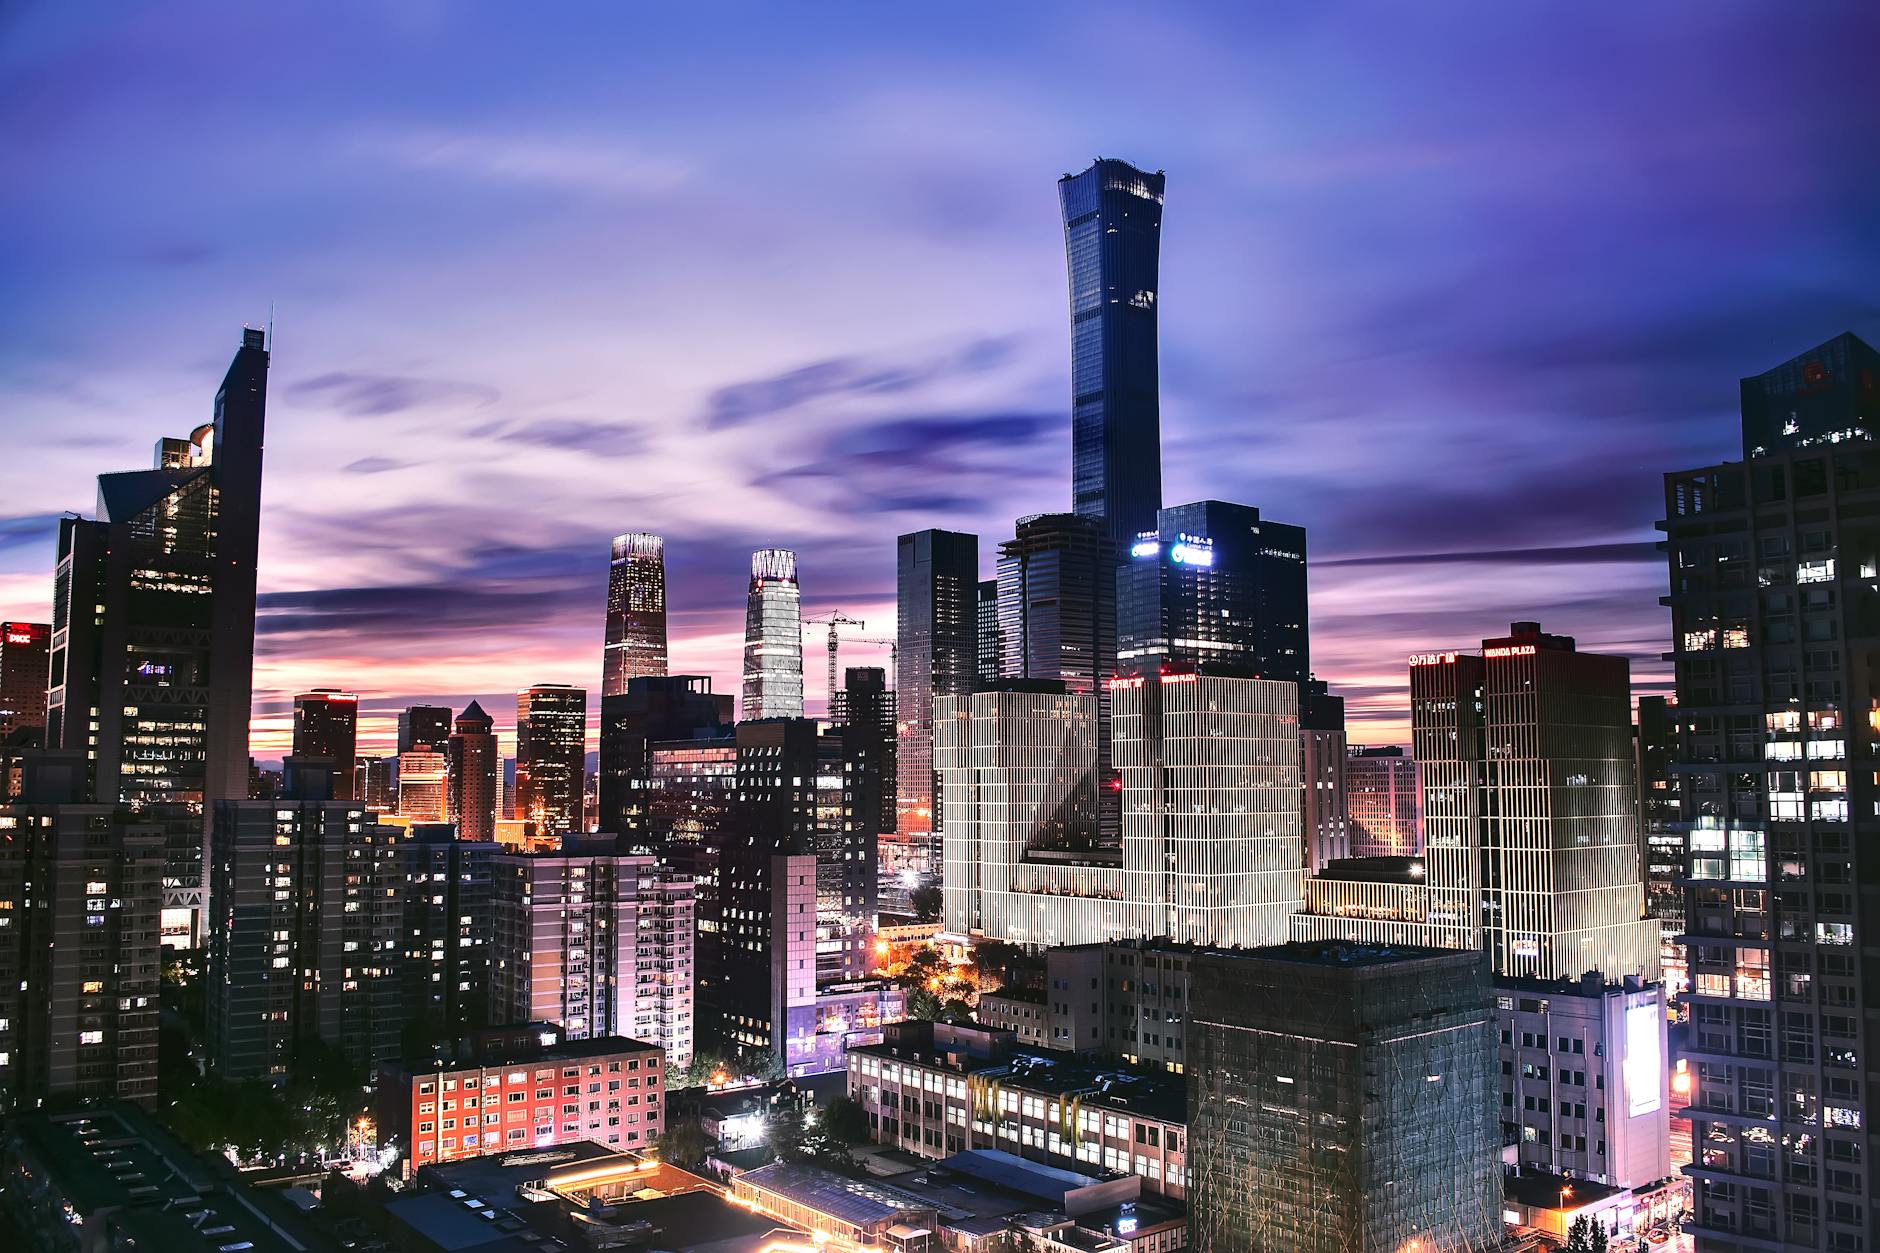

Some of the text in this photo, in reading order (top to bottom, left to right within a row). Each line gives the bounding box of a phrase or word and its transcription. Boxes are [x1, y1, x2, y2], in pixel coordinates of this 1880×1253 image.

[9, 634, 31, 643] PICC
[1484, 645, 1536, 657] WANDA PLAZA
[1179, 673, 1196, 682] PLAZA
